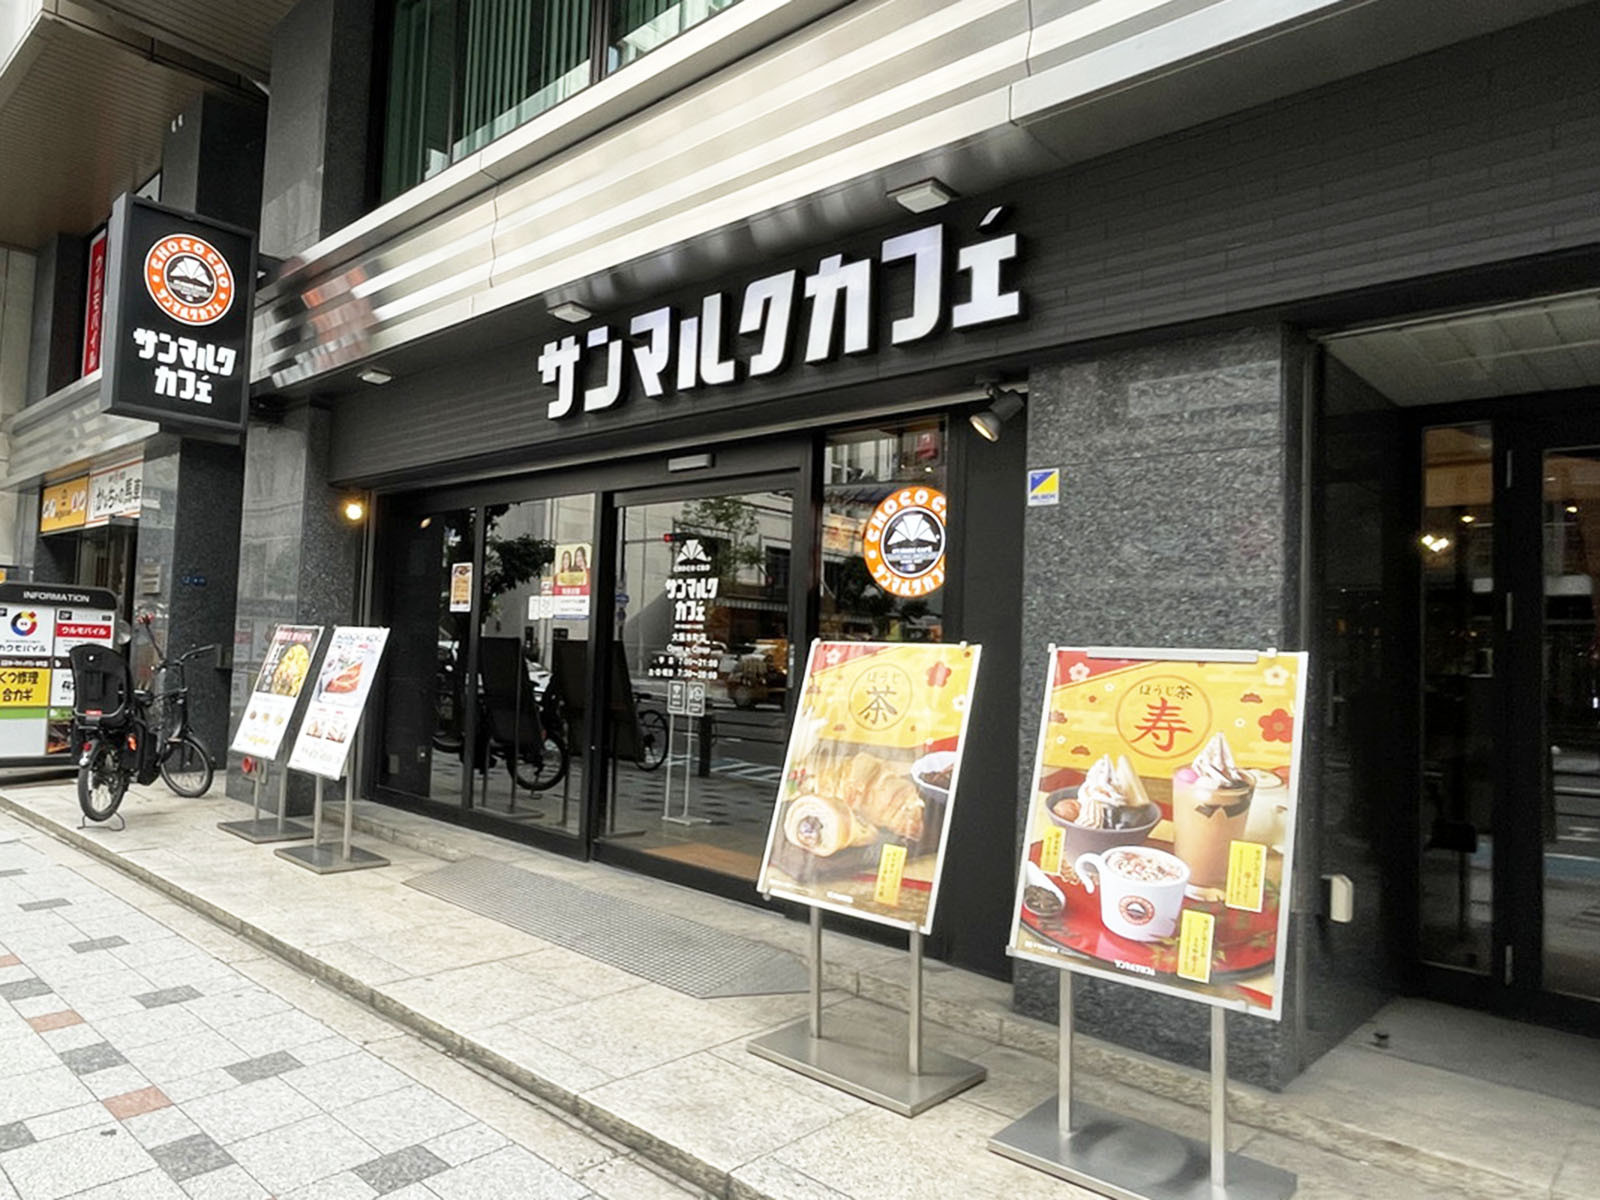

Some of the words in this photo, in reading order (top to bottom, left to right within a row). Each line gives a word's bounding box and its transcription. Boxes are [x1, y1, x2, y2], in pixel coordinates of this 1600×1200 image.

[151, 239, 204, 269] CHOCO
[207, 253, 229, 288] CRO
[538, 206, 1020, 419] サンマルクカフェ
[133, 327, 236, 376] サンマルク
[154, 365, 213, 404] カフェ
[866, 489, 928, 542] CHOCO
[23, 591, 90, 602] INFORMATION
[665, 578, 719, 599] サンマルク
[675, 600, 706, 621] カフェ
[0, 671, 39, 684] くつ修理
[2, 688, 33, 701] 合カギ
[1139, 685, 1192, 700] ほうじ茶
[857, 685, 898, 725] 茶
[1131, 697, 1192, 752] 寿
